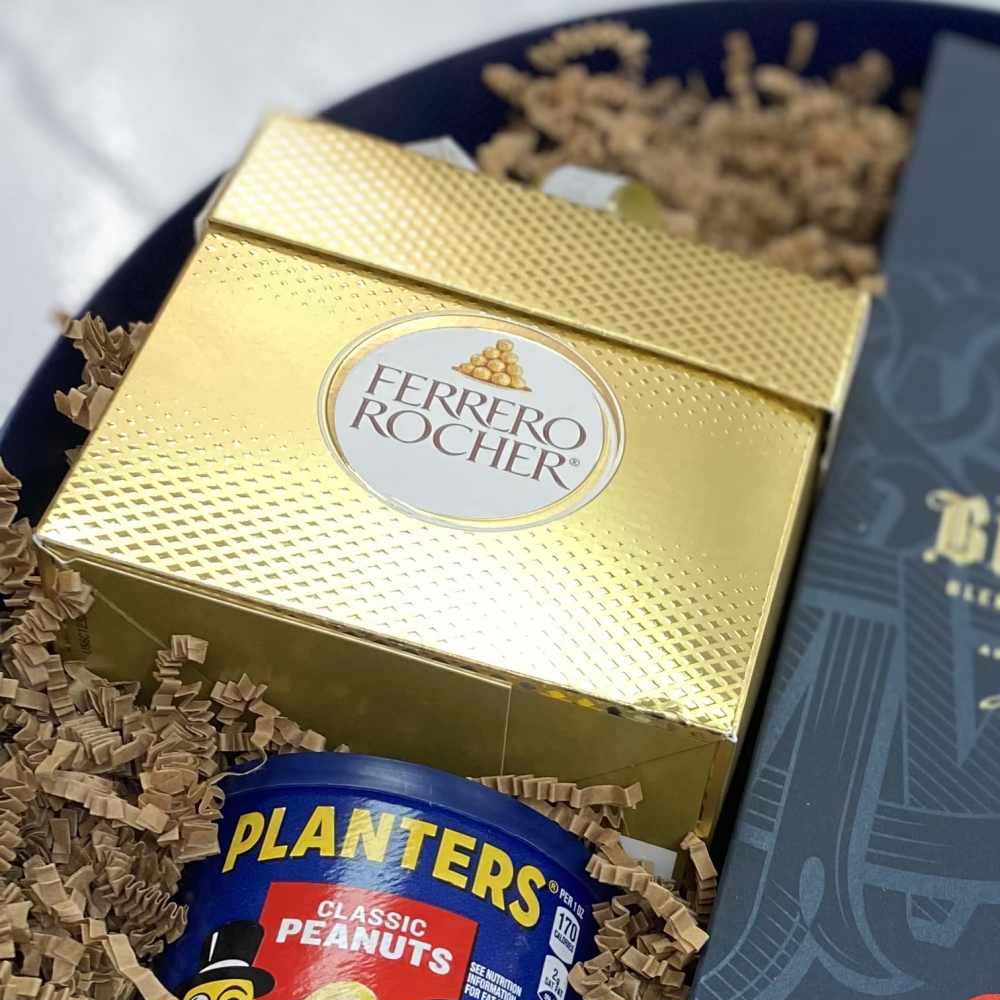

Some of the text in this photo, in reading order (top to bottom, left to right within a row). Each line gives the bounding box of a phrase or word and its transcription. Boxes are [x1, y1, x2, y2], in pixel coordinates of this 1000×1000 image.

[364, 363, 588, 451] FERRERO
[559, 888, 574, 907] PER
[317, 899, 428, 938] CLASSIC
[559, 913, 578, 942] 170
[275, 918, 453, 975] PEANUTS
[464, 984, 481, 1000] FOR
[470, 961, 523, 997] SEE NUTRITION
